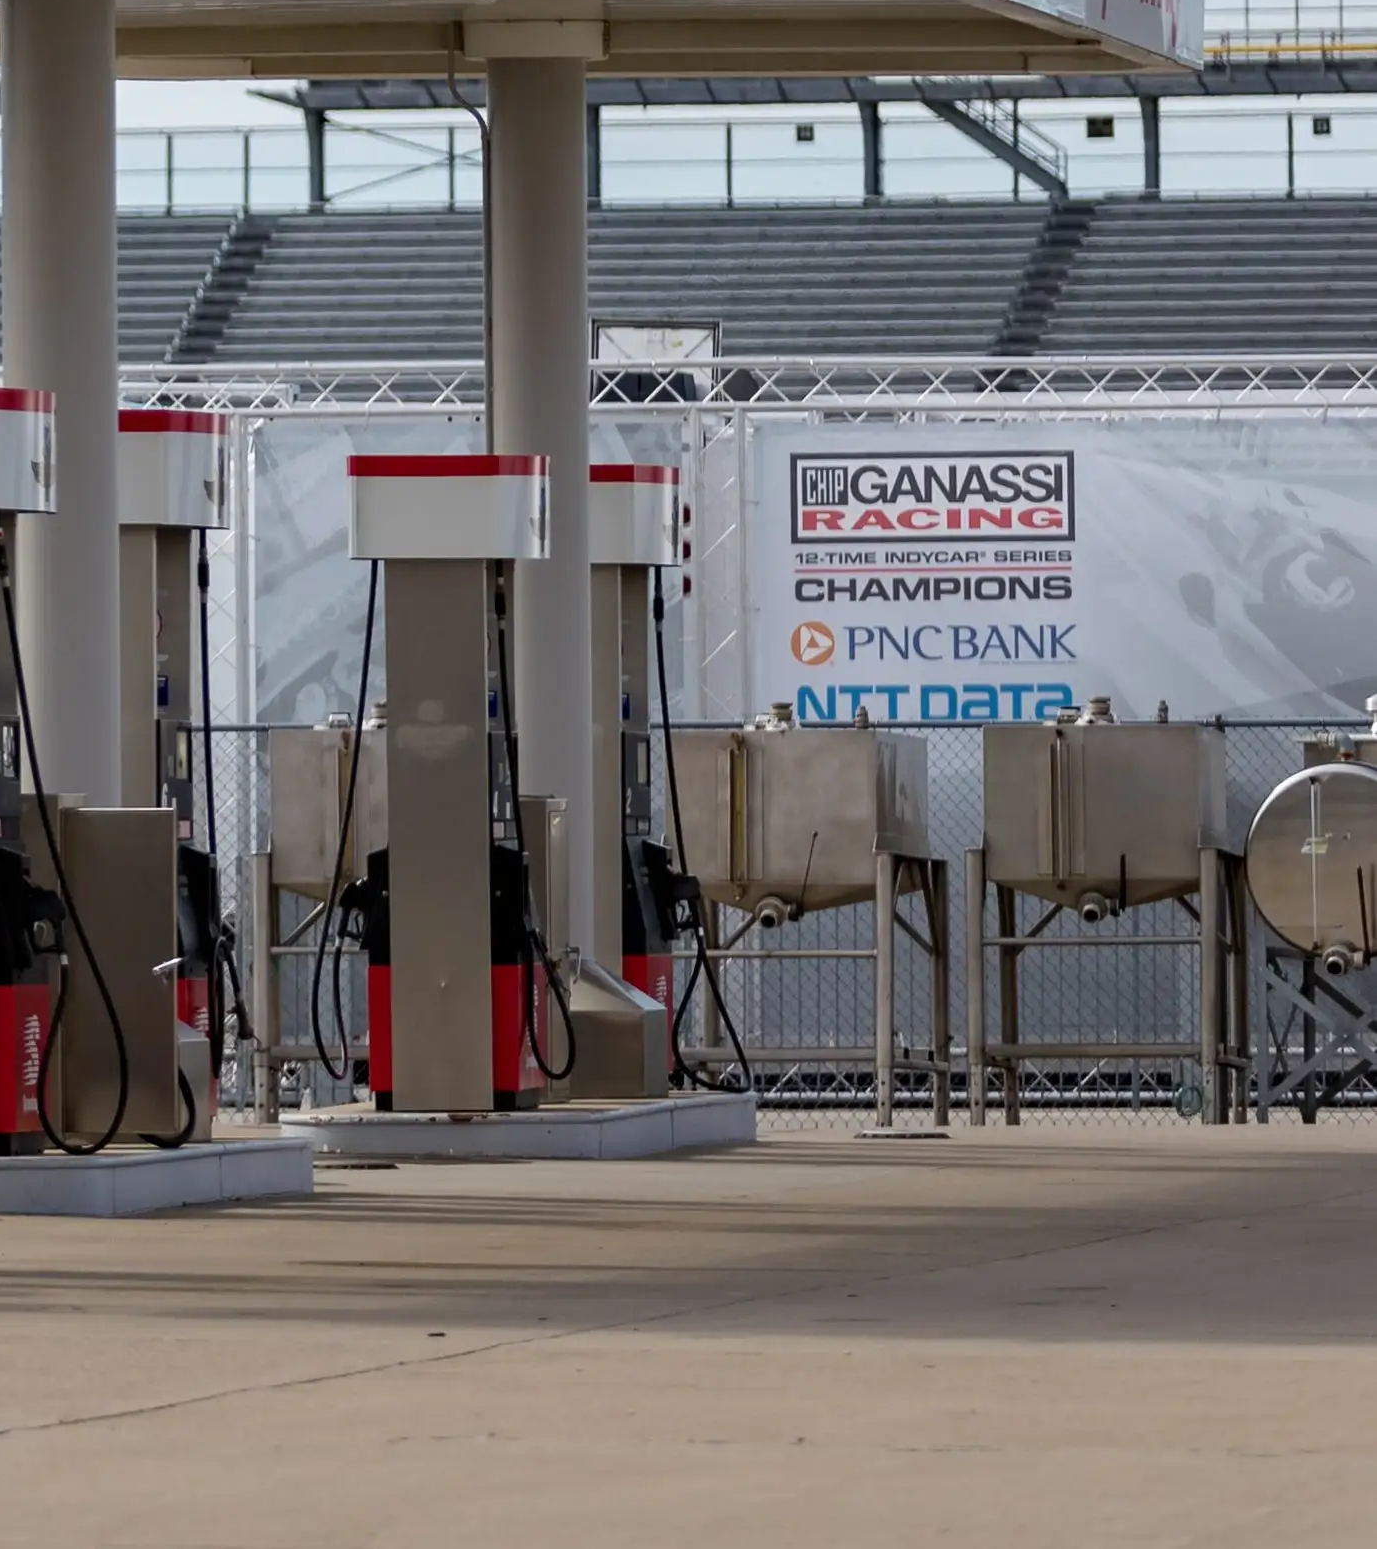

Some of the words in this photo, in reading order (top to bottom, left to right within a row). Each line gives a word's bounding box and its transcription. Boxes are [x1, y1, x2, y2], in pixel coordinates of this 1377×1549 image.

[806, 468, 845, 505] CHIP
[849, 462, 1064, 505] GANASSI
[801, 507, 1063, 531] RACING
[795, 551, 877, 565] 12-TIME
[993, 549, 1073, 563] SERIES
[795, 575, 1073, 602] CHAMPIONS
[843, 624, 944, 661] PNC
[947, 623, 1078, 660] BANK
[796, 683, 911, 721] NTT
